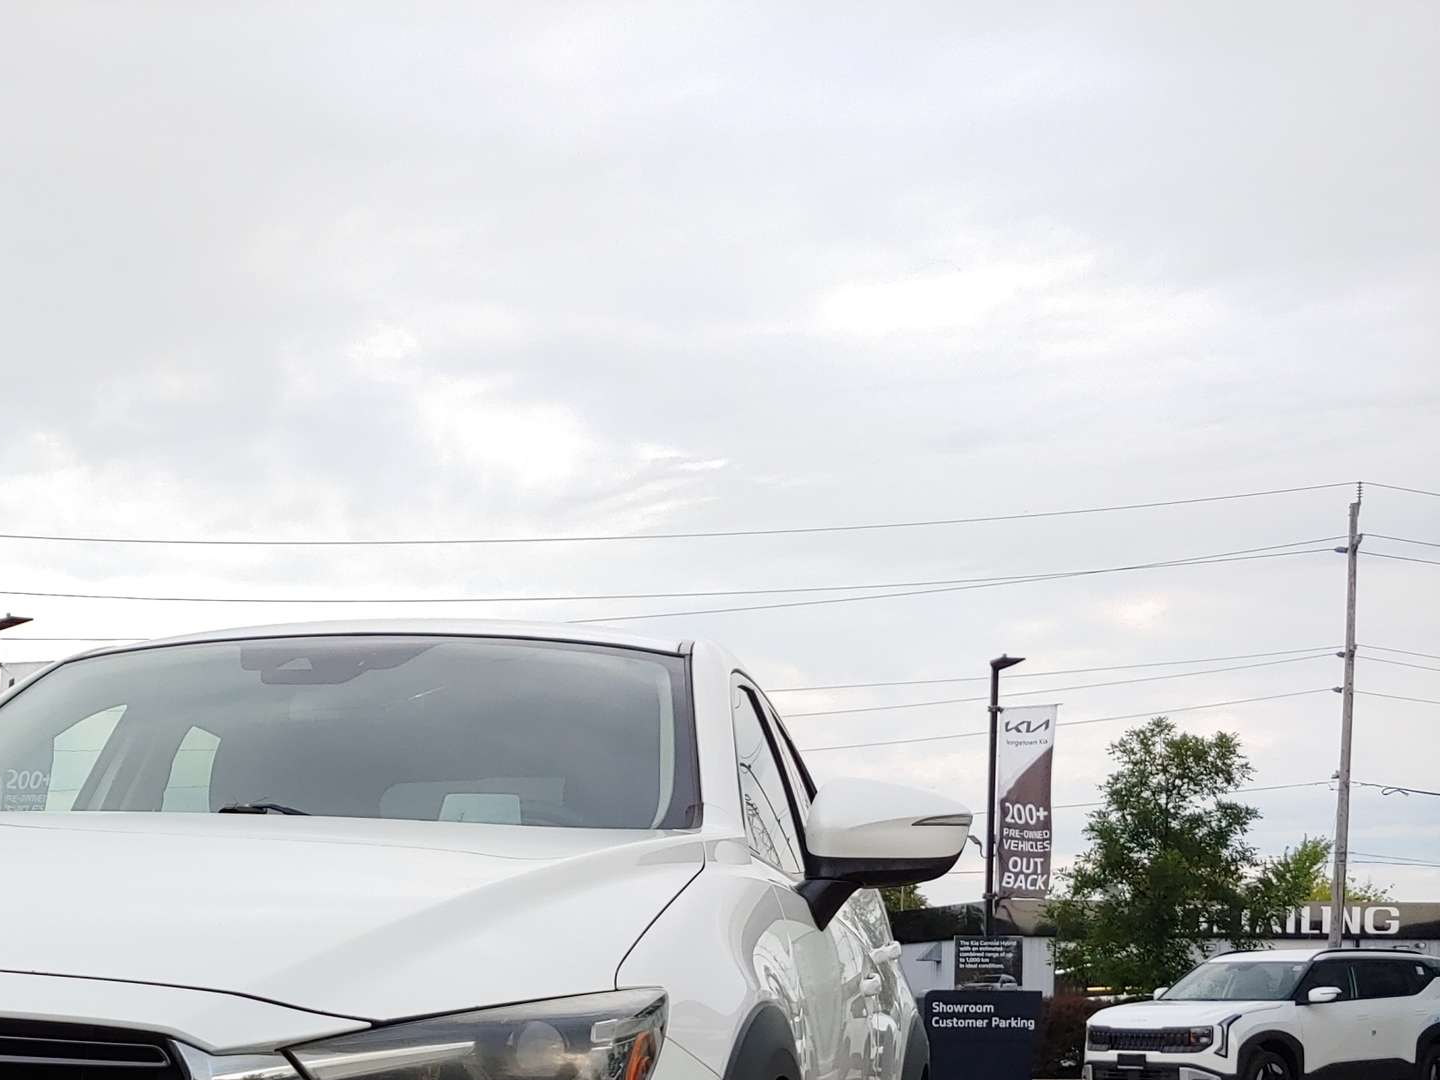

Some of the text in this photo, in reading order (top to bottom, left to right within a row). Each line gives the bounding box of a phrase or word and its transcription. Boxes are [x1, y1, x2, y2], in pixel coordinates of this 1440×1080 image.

[1005, 719, 1050, 733] KIA
[1004, 802, 1048, 825] 200+
[1003, 828, 1050, 840] PRE-OWNED
[1003, 838, 1051, 852] VEHICLES
[1008, 856, 1044, 874] OUT
[1002, 873, 1048, 890] BACK
[932, 1002, 994, 1013] Showroom
[931, 1016, 1035, 1030] Customer Parking
